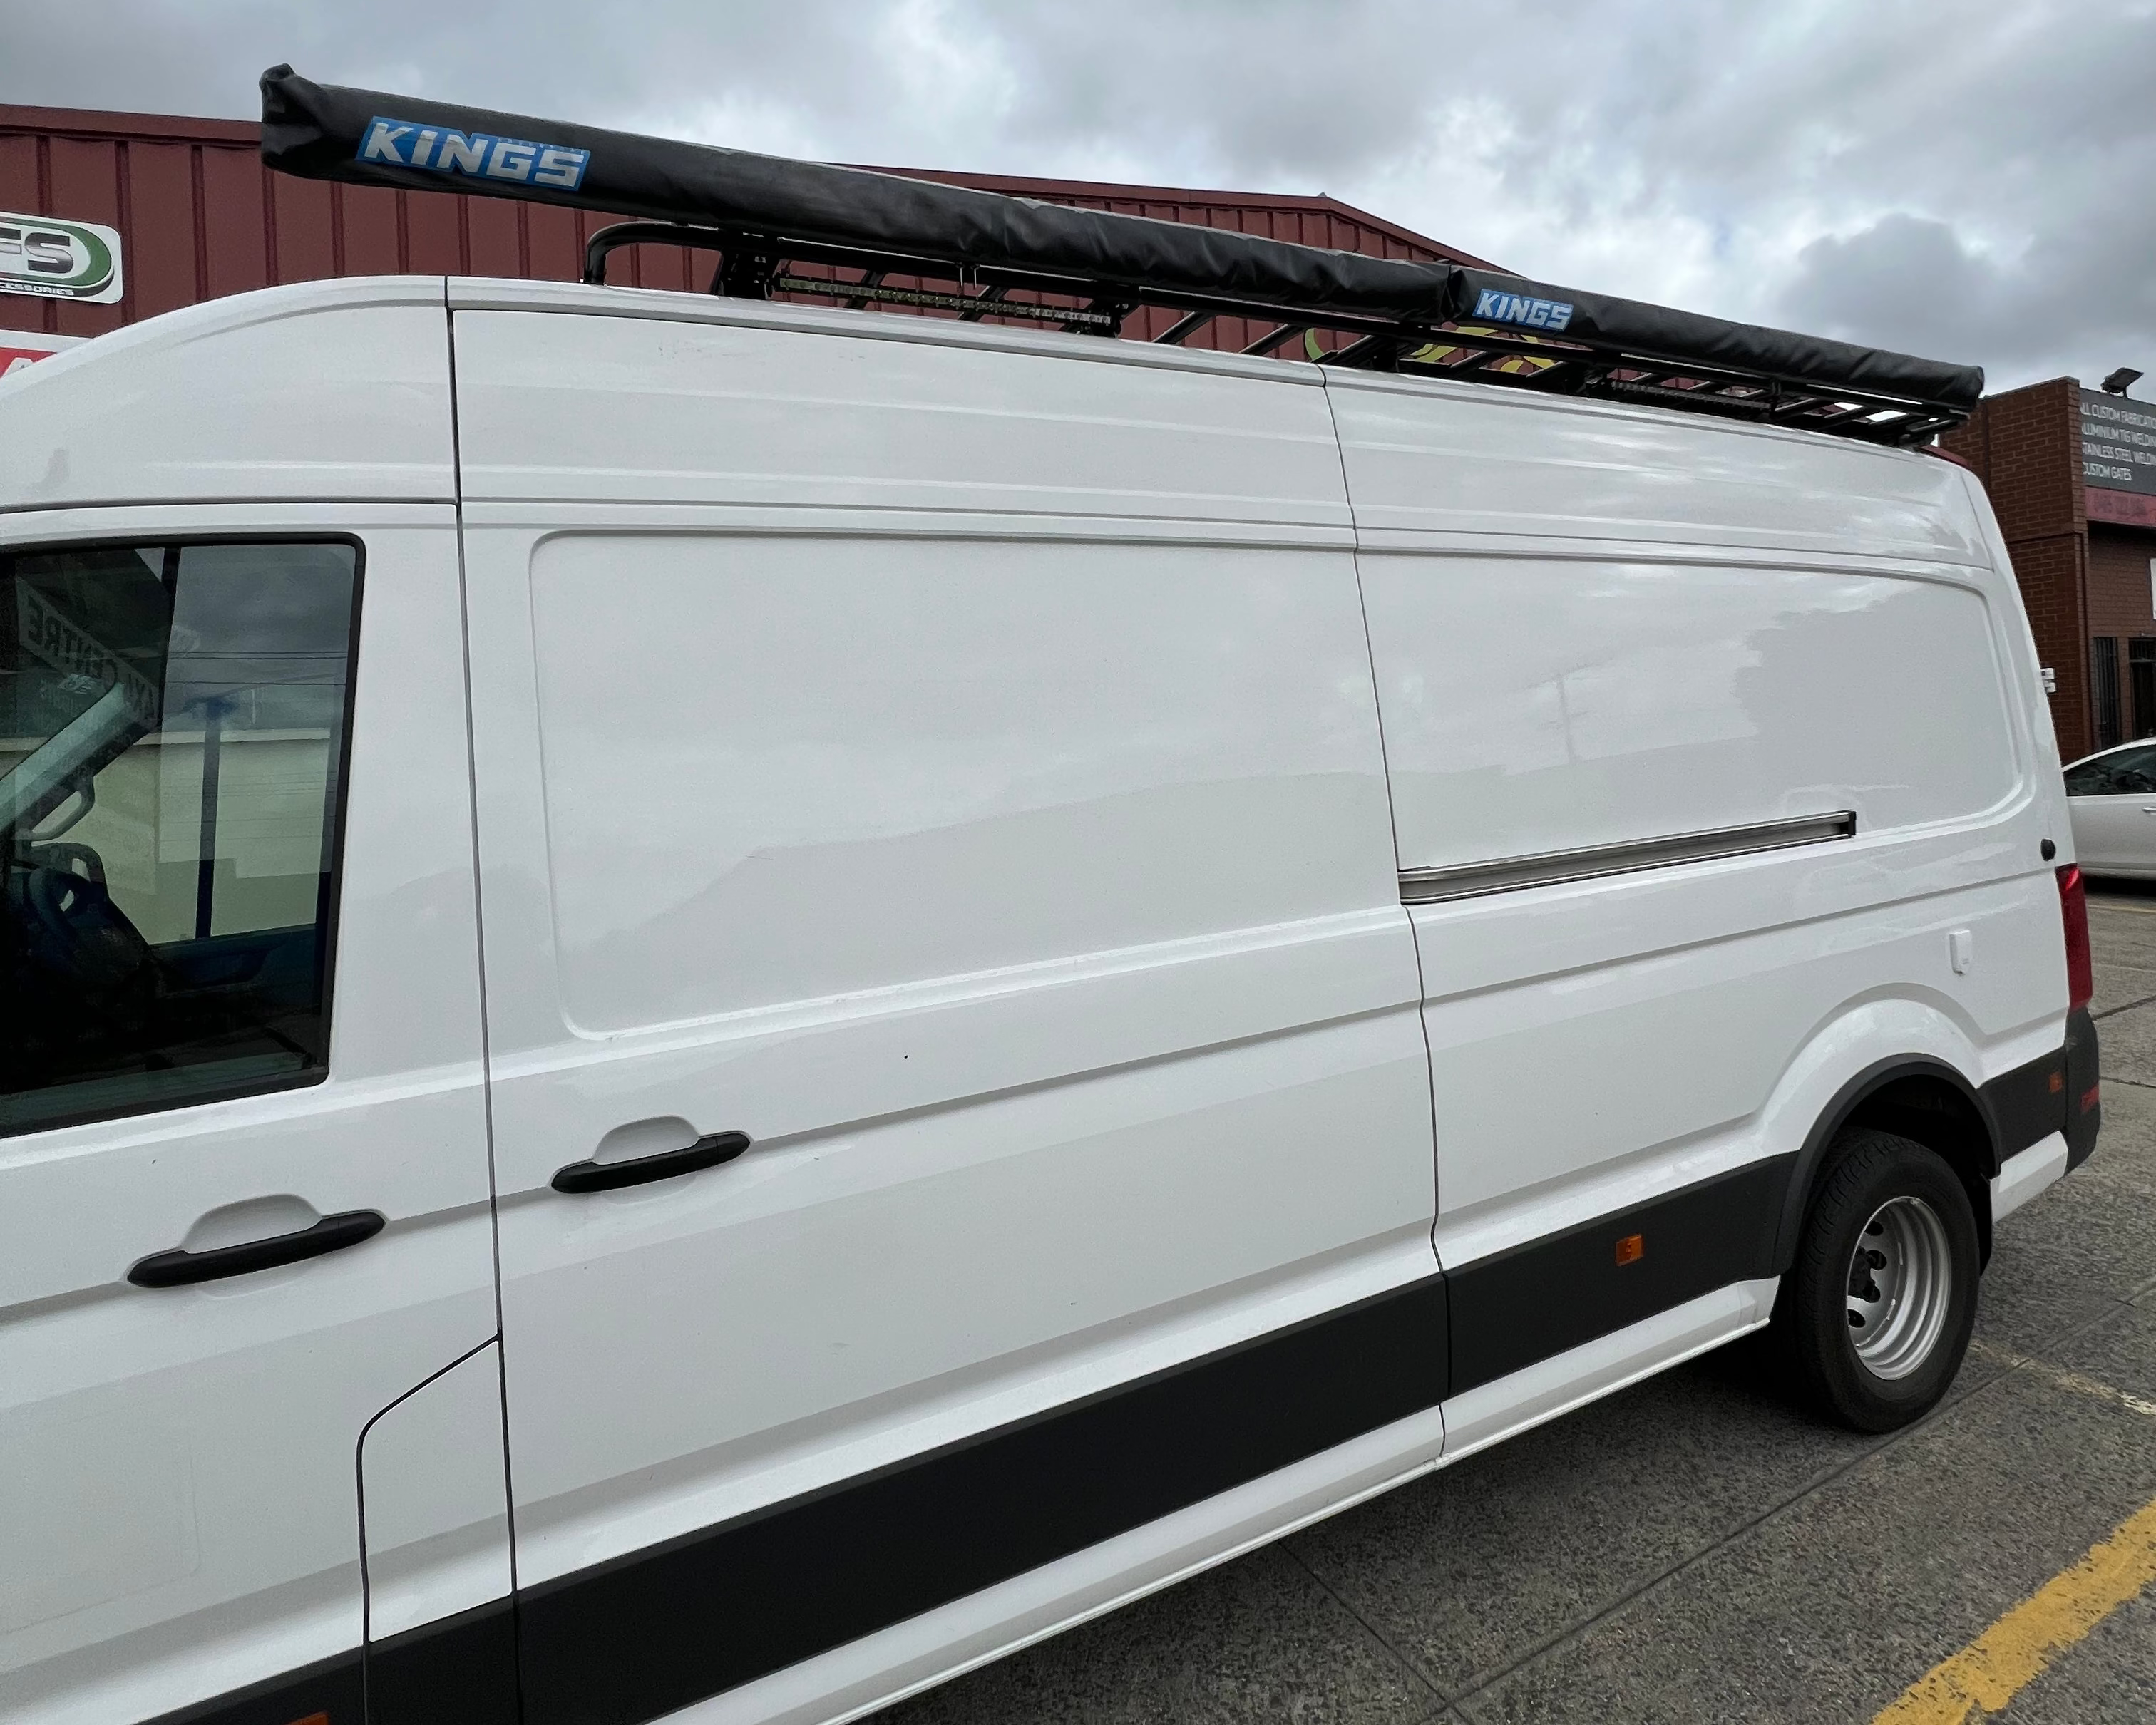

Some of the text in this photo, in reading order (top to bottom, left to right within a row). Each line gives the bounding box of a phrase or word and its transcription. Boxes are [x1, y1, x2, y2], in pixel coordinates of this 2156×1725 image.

[364, 123, 584, 187] KINGS
[1477, 292, 1571, 329] KINGS
[2082, 441, 2114, 458] TAINLESS
[2115, 447, 2133, 463] STEEL
[2111, 466, 2132, 481] GATES
